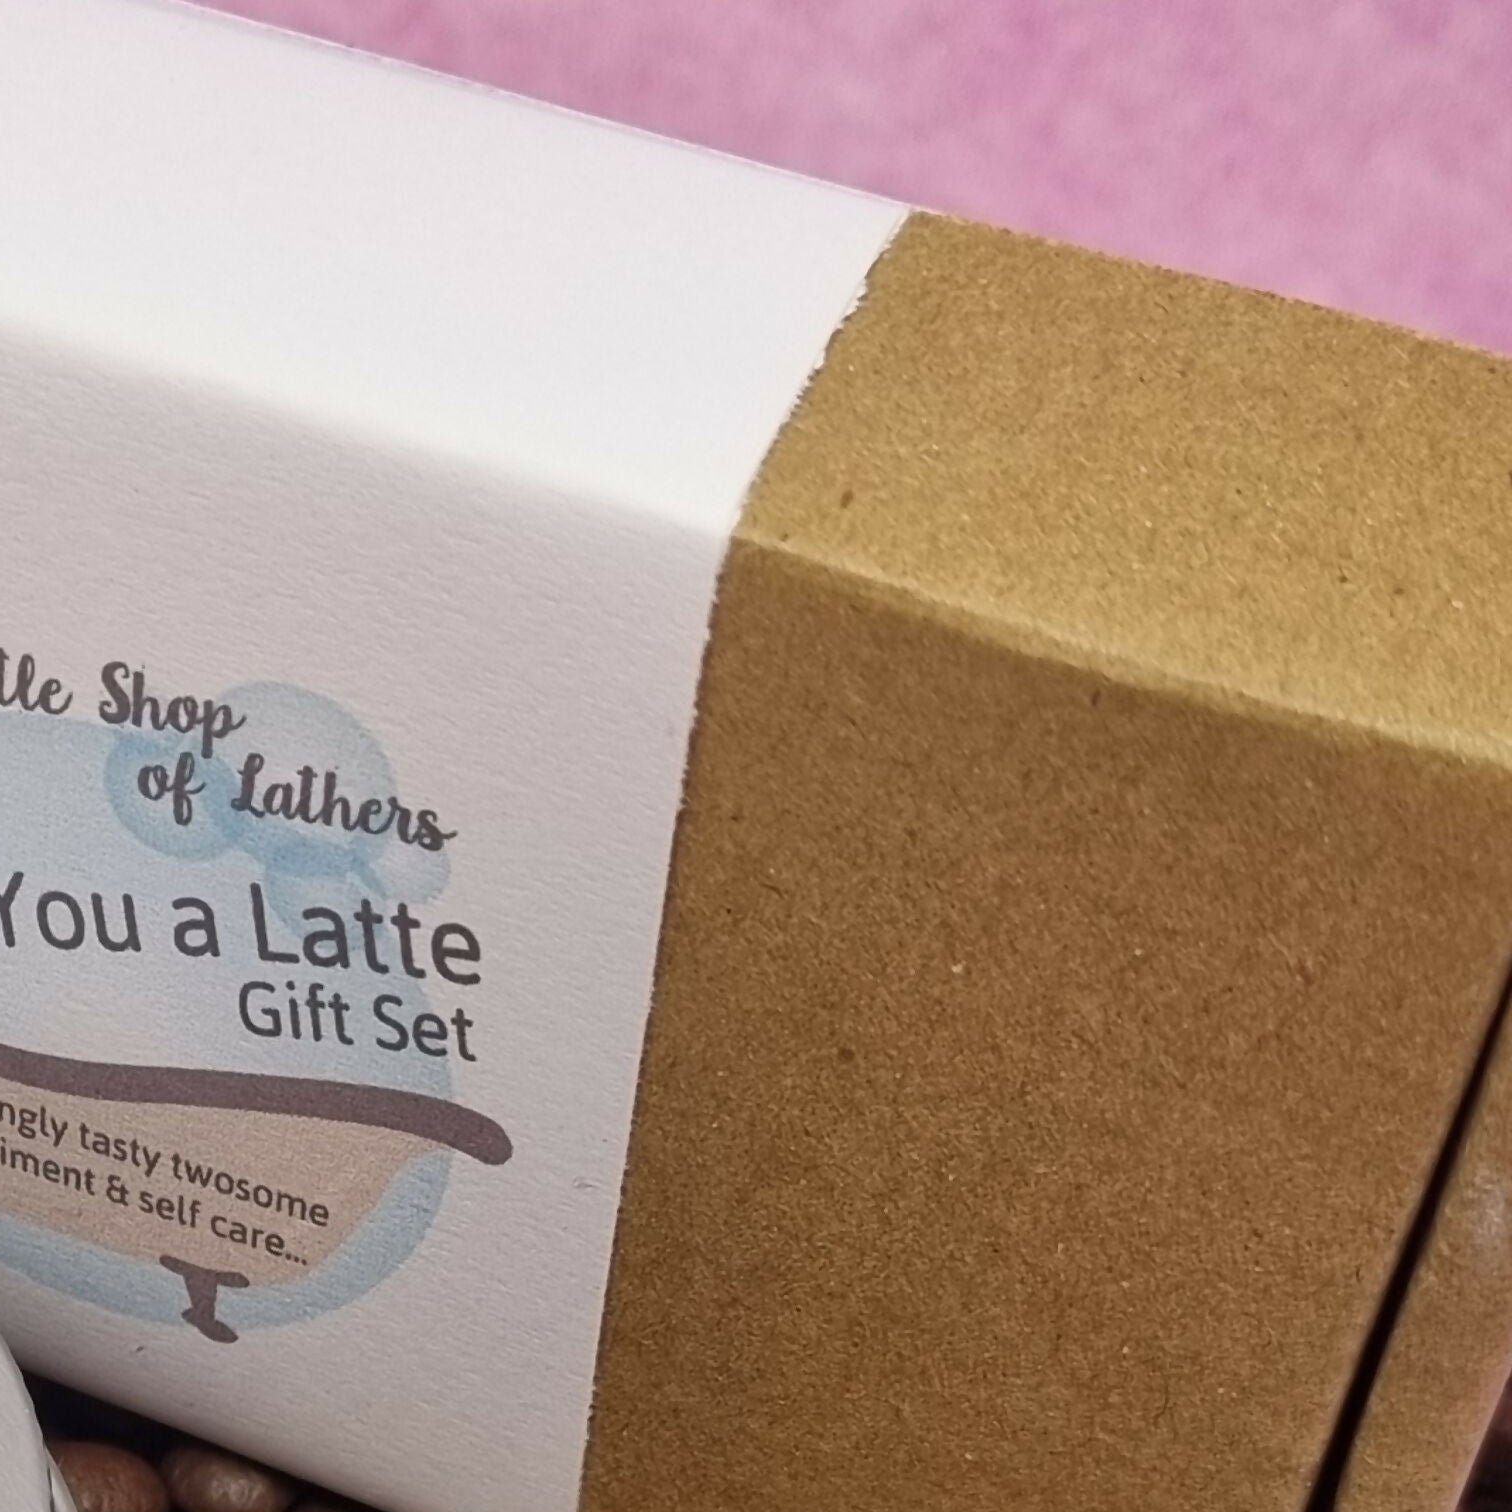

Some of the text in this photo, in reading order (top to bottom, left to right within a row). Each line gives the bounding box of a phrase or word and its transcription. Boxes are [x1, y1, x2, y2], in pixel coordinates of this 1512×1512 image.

[99, 662, 247, 759] Shop
[138, 752, 457, 851] of Lathers
[172, 897, 220, 957] a
[250, 882, 483, 988] Latte
[239, 981, 476, 1061] Gift Set
[79, 1123, 161, 1177] tasty
[172, 1153, 329, 1228] twosome
[106, 1175, 129, 1206] &
[139, 1187, 202, 1229] self
[211, 1216, 307, 1265] care...
